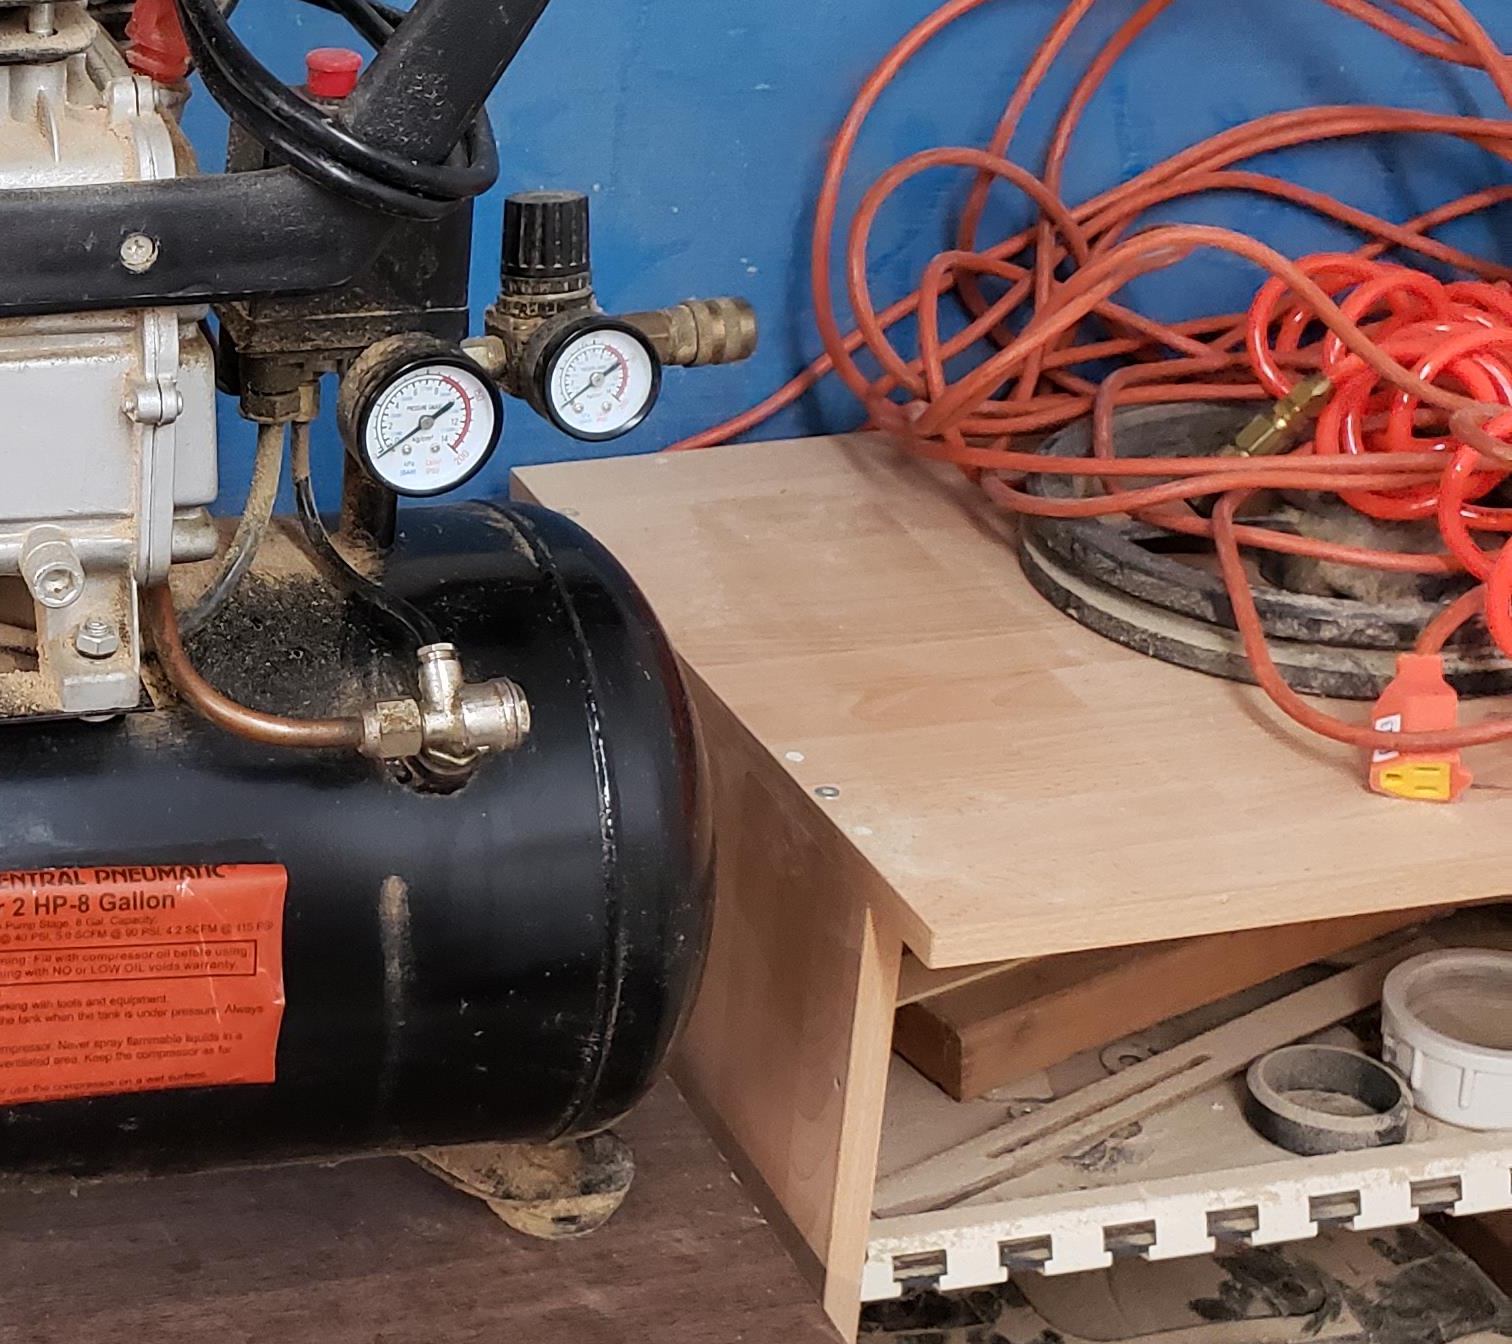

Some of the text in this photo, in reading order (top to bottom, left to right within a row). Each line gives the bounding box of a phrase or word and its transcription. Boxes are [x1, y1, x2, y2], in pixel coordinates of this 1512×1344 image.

[94, 864, 226, 885] PNEUMATIC
[12, 896, 26, 917] 2
[34, 894, 90, 916] HP-8
[99, 892, 176, 912] Gallon
[52, 965, 72, 976] NO
[90, 963, 121, 975] LOW
[124, 962, 144, 974] OIL
